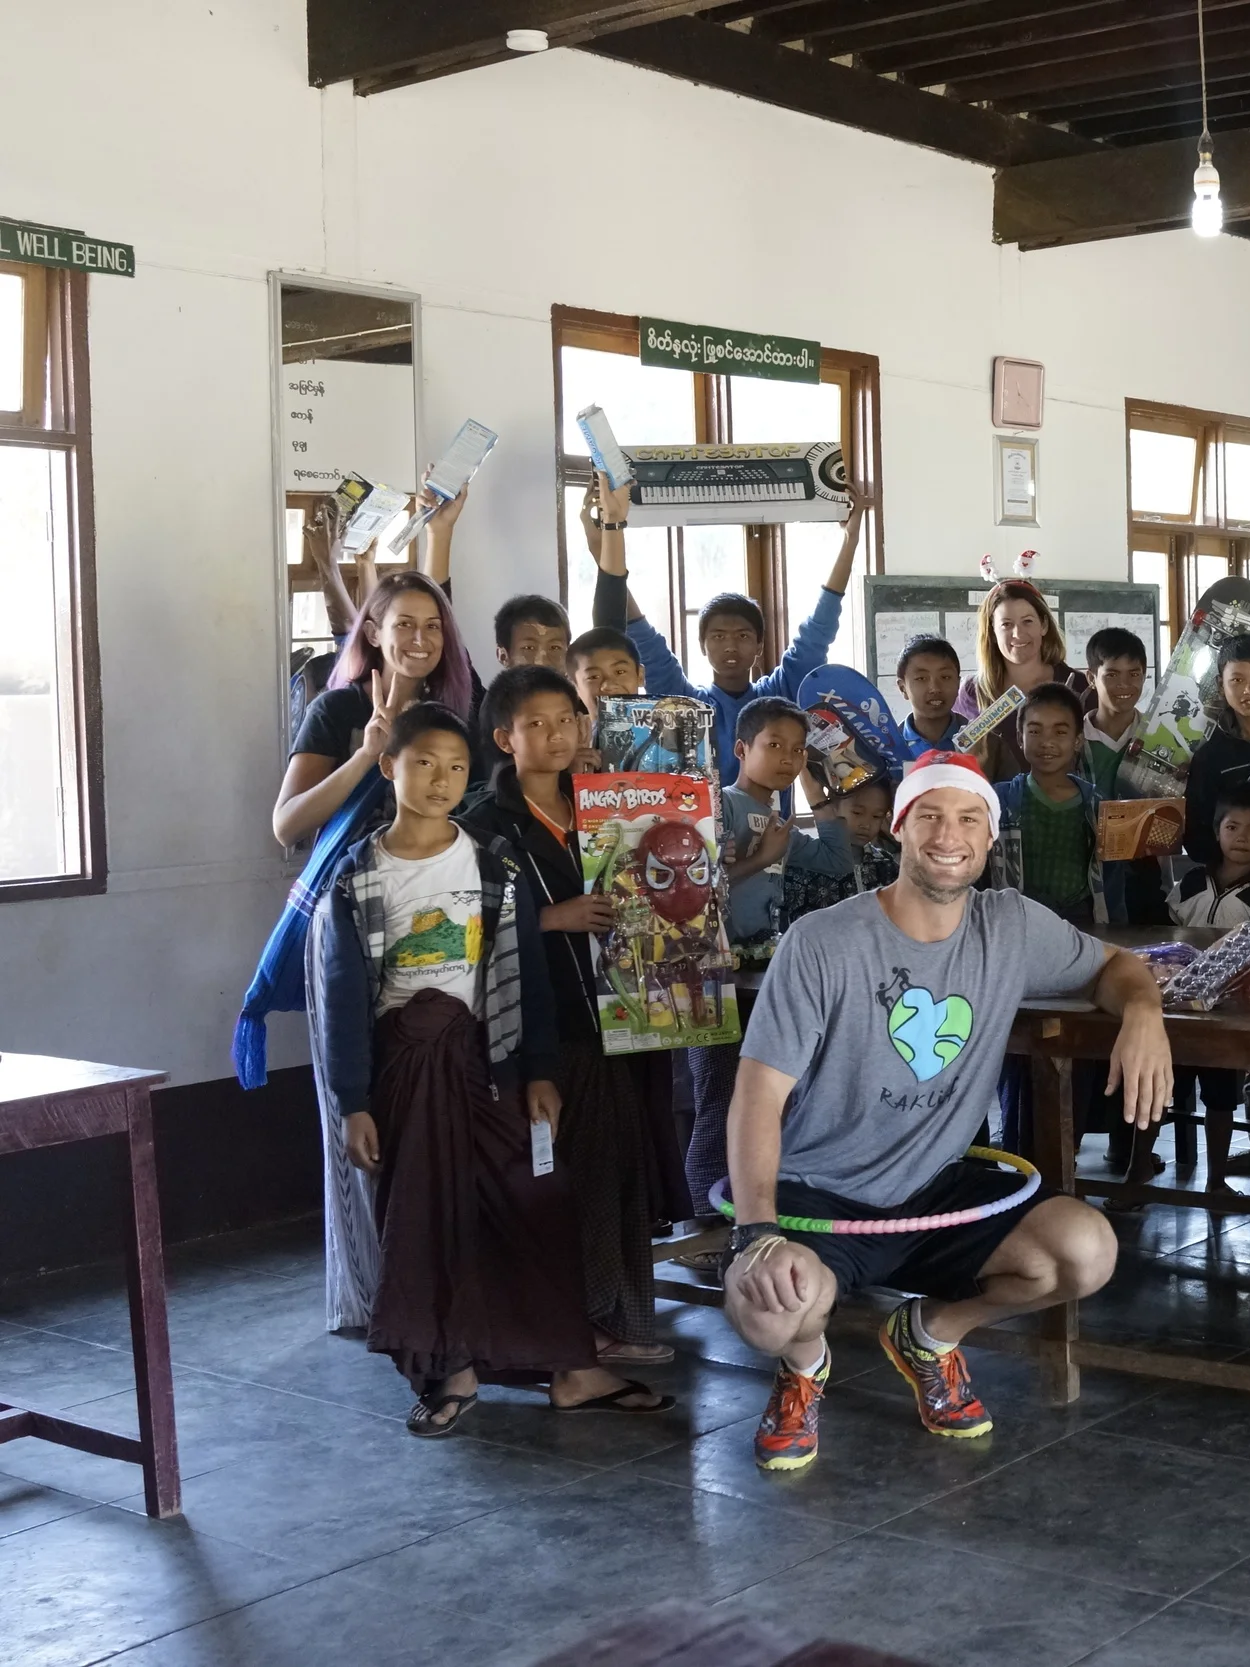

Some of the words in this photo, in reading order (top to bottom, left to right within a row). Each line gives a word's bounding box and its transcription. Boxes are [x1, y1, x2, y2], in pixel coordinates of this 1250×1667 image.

[17, 230, 67, 261] WELL
[71, 241, 132, 272] BEING.
[968, 700, 1011, 738] DOMINOES
[579, 788, 622, 811] ANGRY
[624, 788, 667, 810] BIRDS
[708, 920, 717, 928] 10
